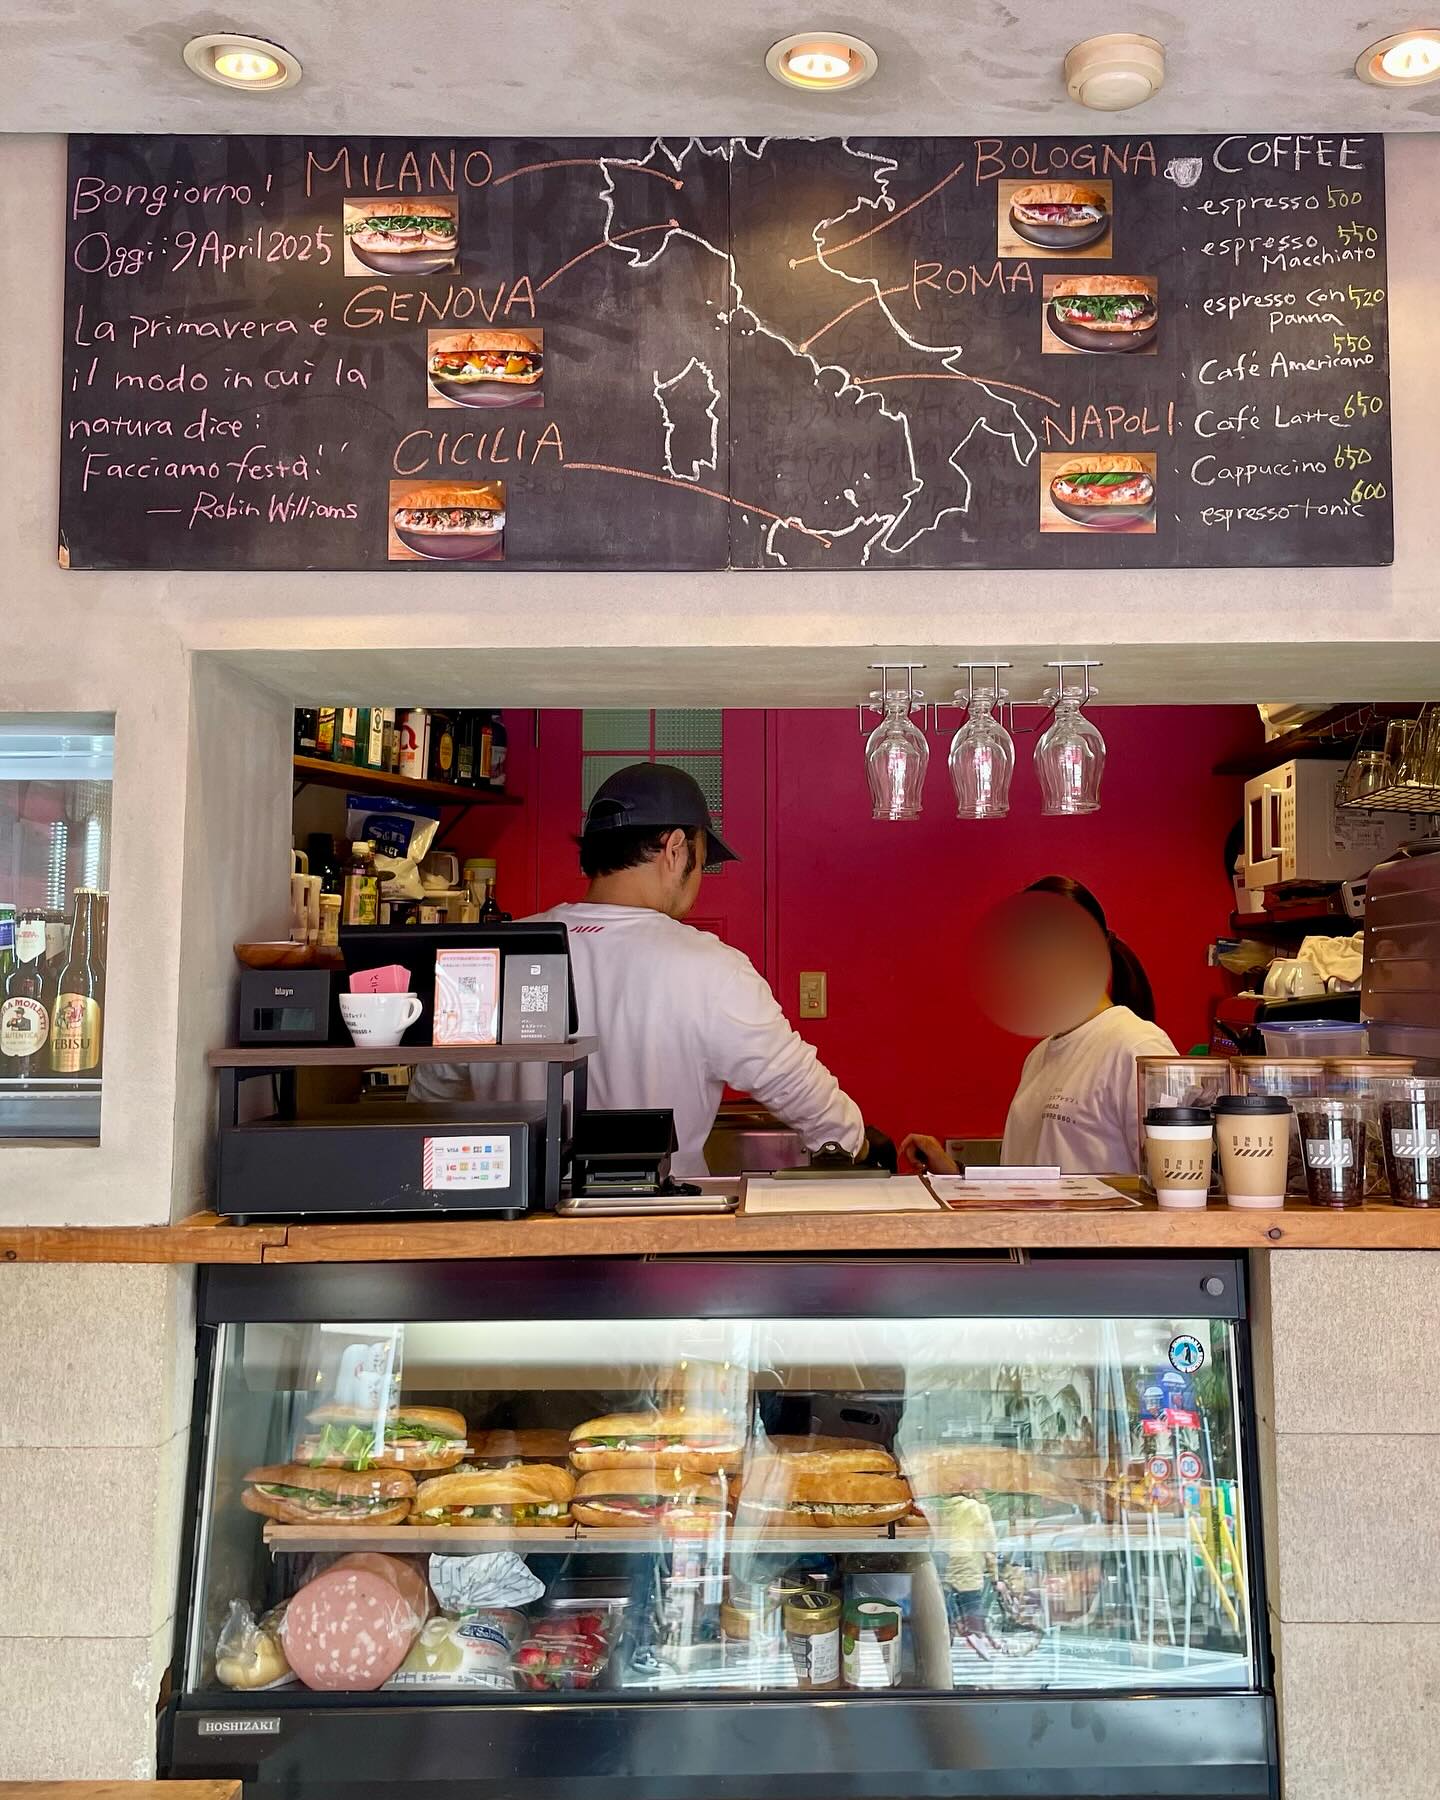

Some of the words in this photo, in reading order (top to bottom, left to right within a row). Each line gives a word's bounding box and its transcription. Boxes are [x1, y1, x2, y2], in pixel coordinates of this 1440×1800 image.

[305, 146, 493, 198] MILANO
[974, 138, 1158, 187] BOLOGNA
[1213, 135, 1366, 173] COFFEE
[1197, 194, 1319, 227] espresso
[1326, 185, 1362, 208] 500
[1200, 235, 1318, 266] espresso
[1337, 221, 1378, 246] 550
[1262, 246, 1376, 272] Macchiato
[343, 275, 536, 328] GENOVA
[913, 259, 1034, 310] ROMA
[1203, 293, 1296, 320] espresso
[1347, 284, 1385, 310] 520
[75, 304, 115, 346] La
[130, 314, 298, 348] primavera
[1333, 332, 1372, 354] 550
[72, 357, 99, 391] il
[115, 363, 208, 391] modo
[223, 368, 253, 389] in
[335, 358, 368, 391] la
[1199, 350, 1260, 385] Café
[1270, 351, 1374, 378] Americano
[69, 417, 173, 440] natura
[1043, 401, 1175, 446] NAPOLI
[1194, 404, 1260, 438] Café
[1274, 404, 1351, 428] Latte
[1344, 391, 1383, 418] 650
[393, 422, 564, 476] CICILIA
[1190, 454, 1327, 487] Cappuccino
[1334, 444, 1372, 471] 650
[189, 491, 260, 529] Robin
[269, 492, 358, 524] Williams
[1351, 479, 1387, 504] 600
[205, 1721, 274, 1733] HOSHIZAKI
